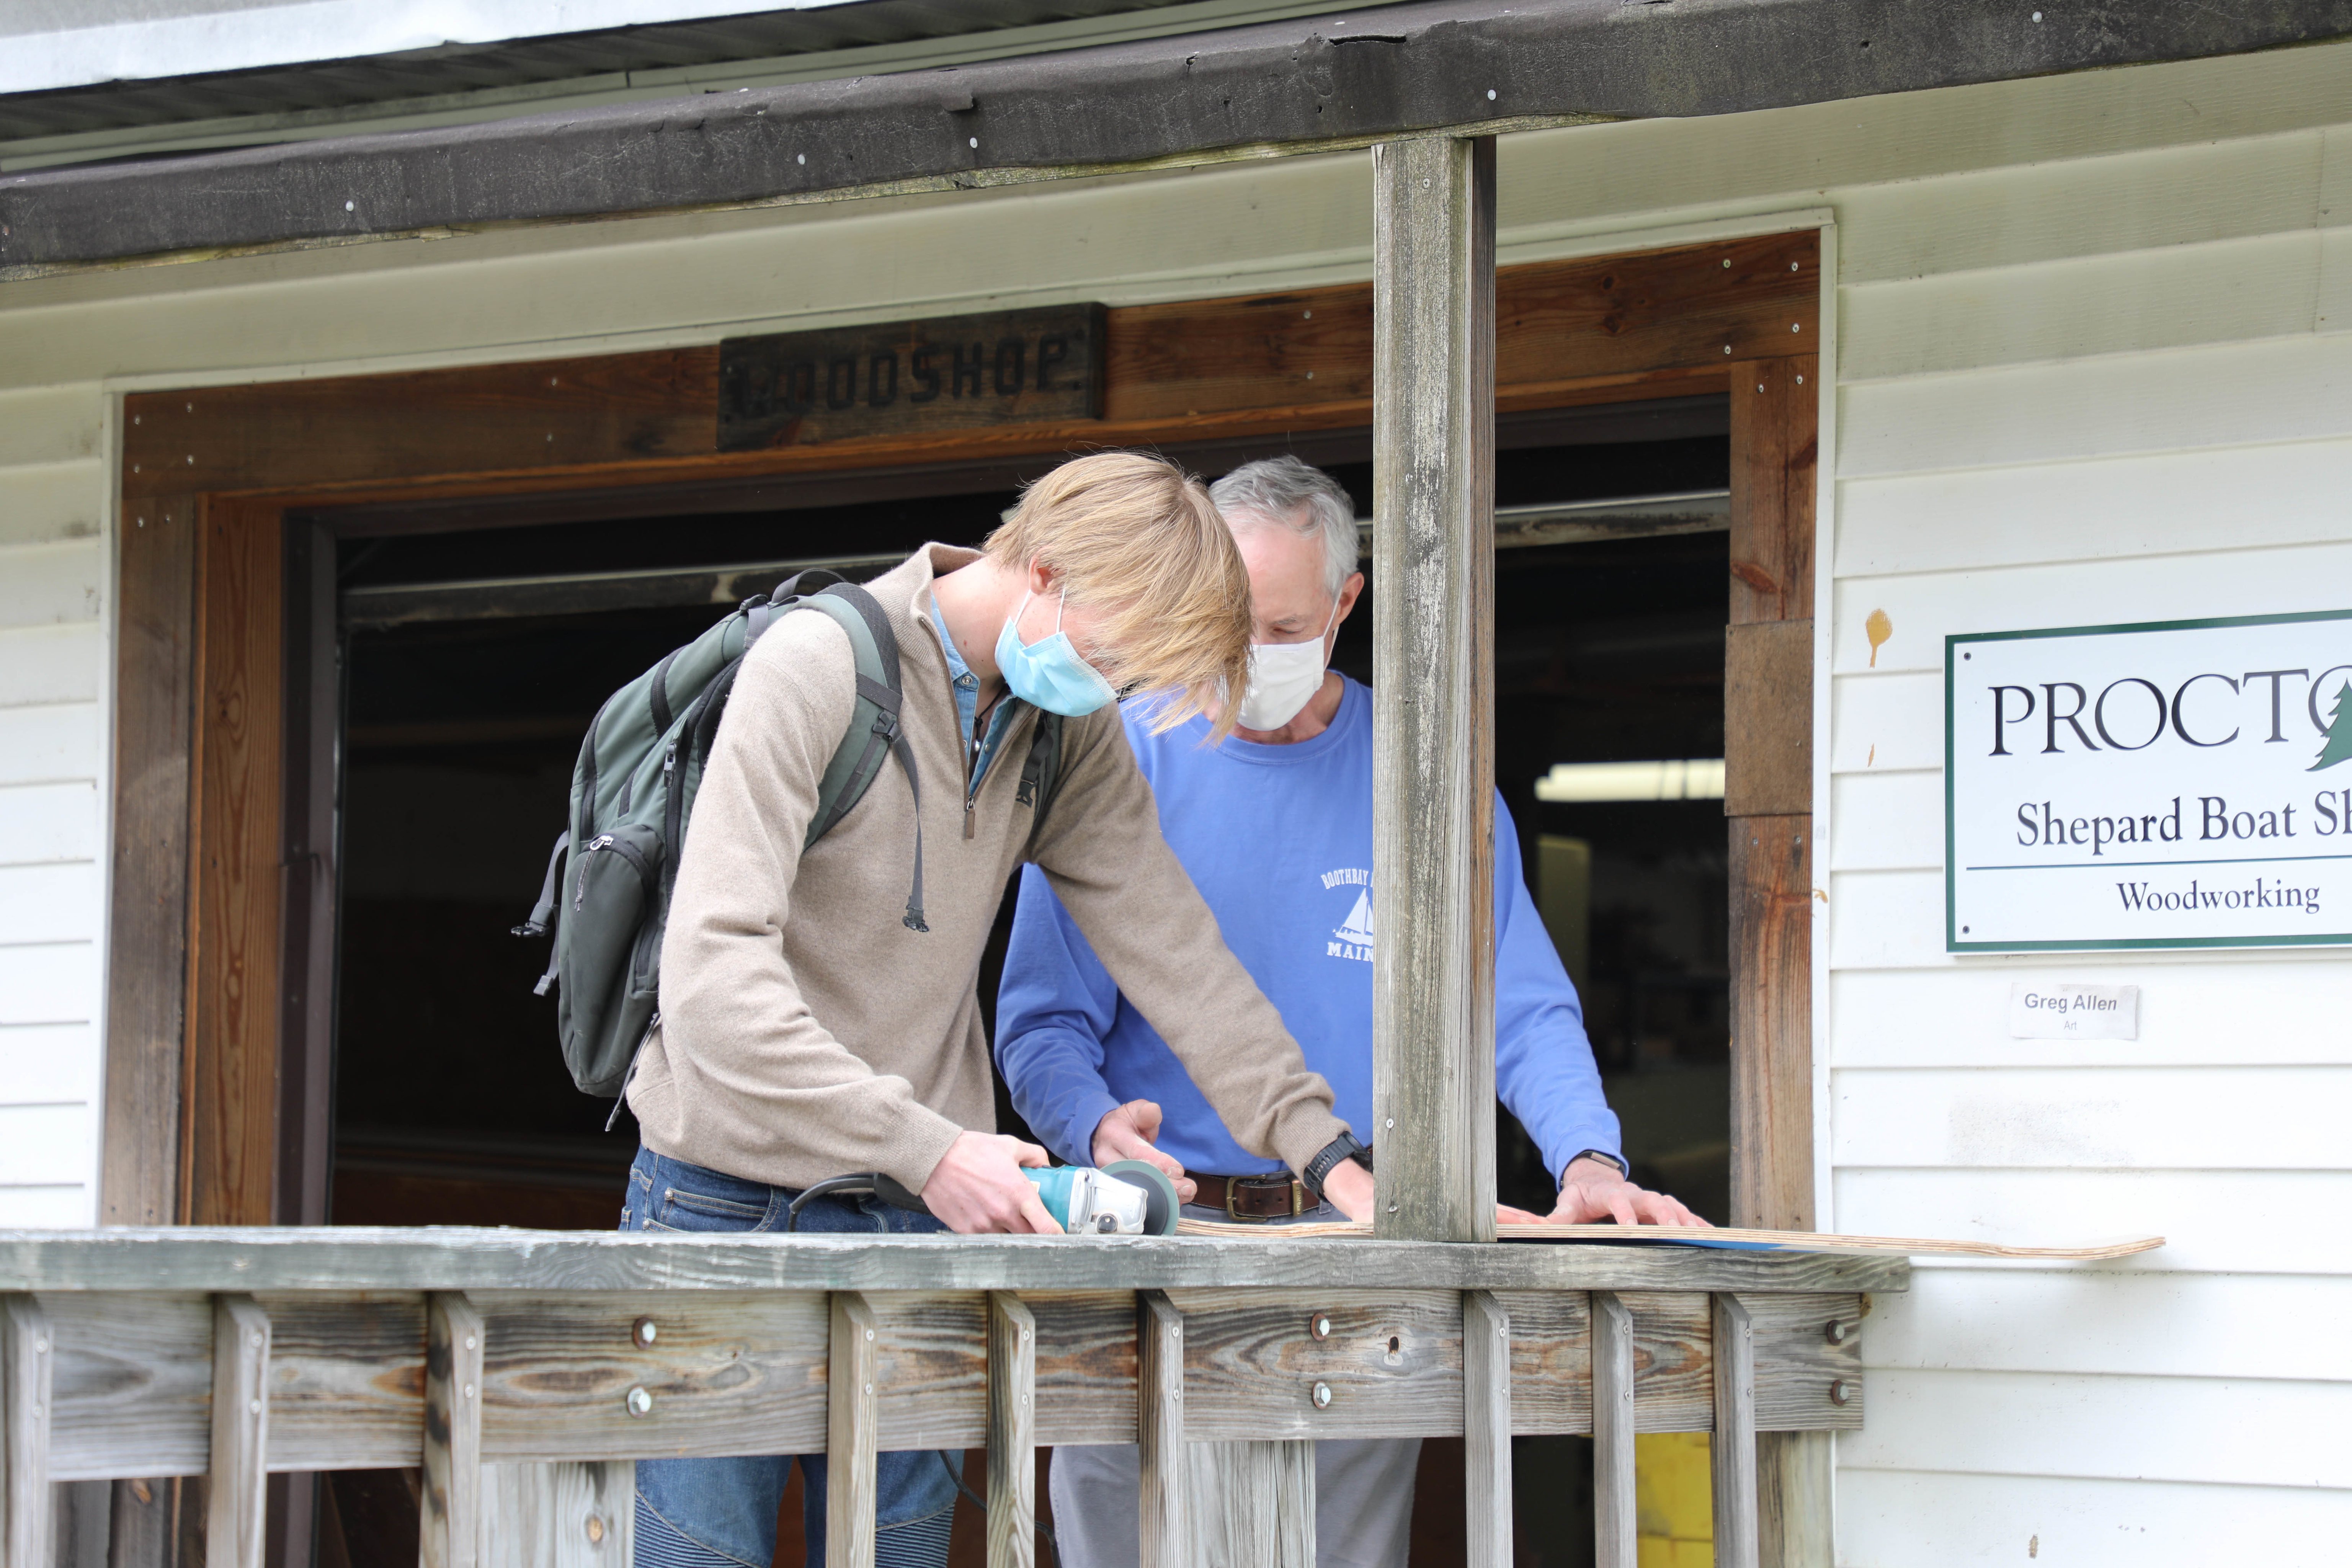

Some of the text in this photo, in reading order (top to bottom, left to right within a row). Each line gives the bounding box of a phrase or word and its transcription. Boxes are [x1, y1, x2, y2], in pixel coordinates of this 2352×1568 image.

[2017, 795, 2184, 856] Shepard
[2197, 796, 2297, 841] Boat
[1321, 868, 1369, 890] BOOTHBAY
[2116, 877, 2320, 915] Woodworking
[2024, 993, 2117, 1014] Greg Allen
[2064, 1020, 2078, 1031] Art
